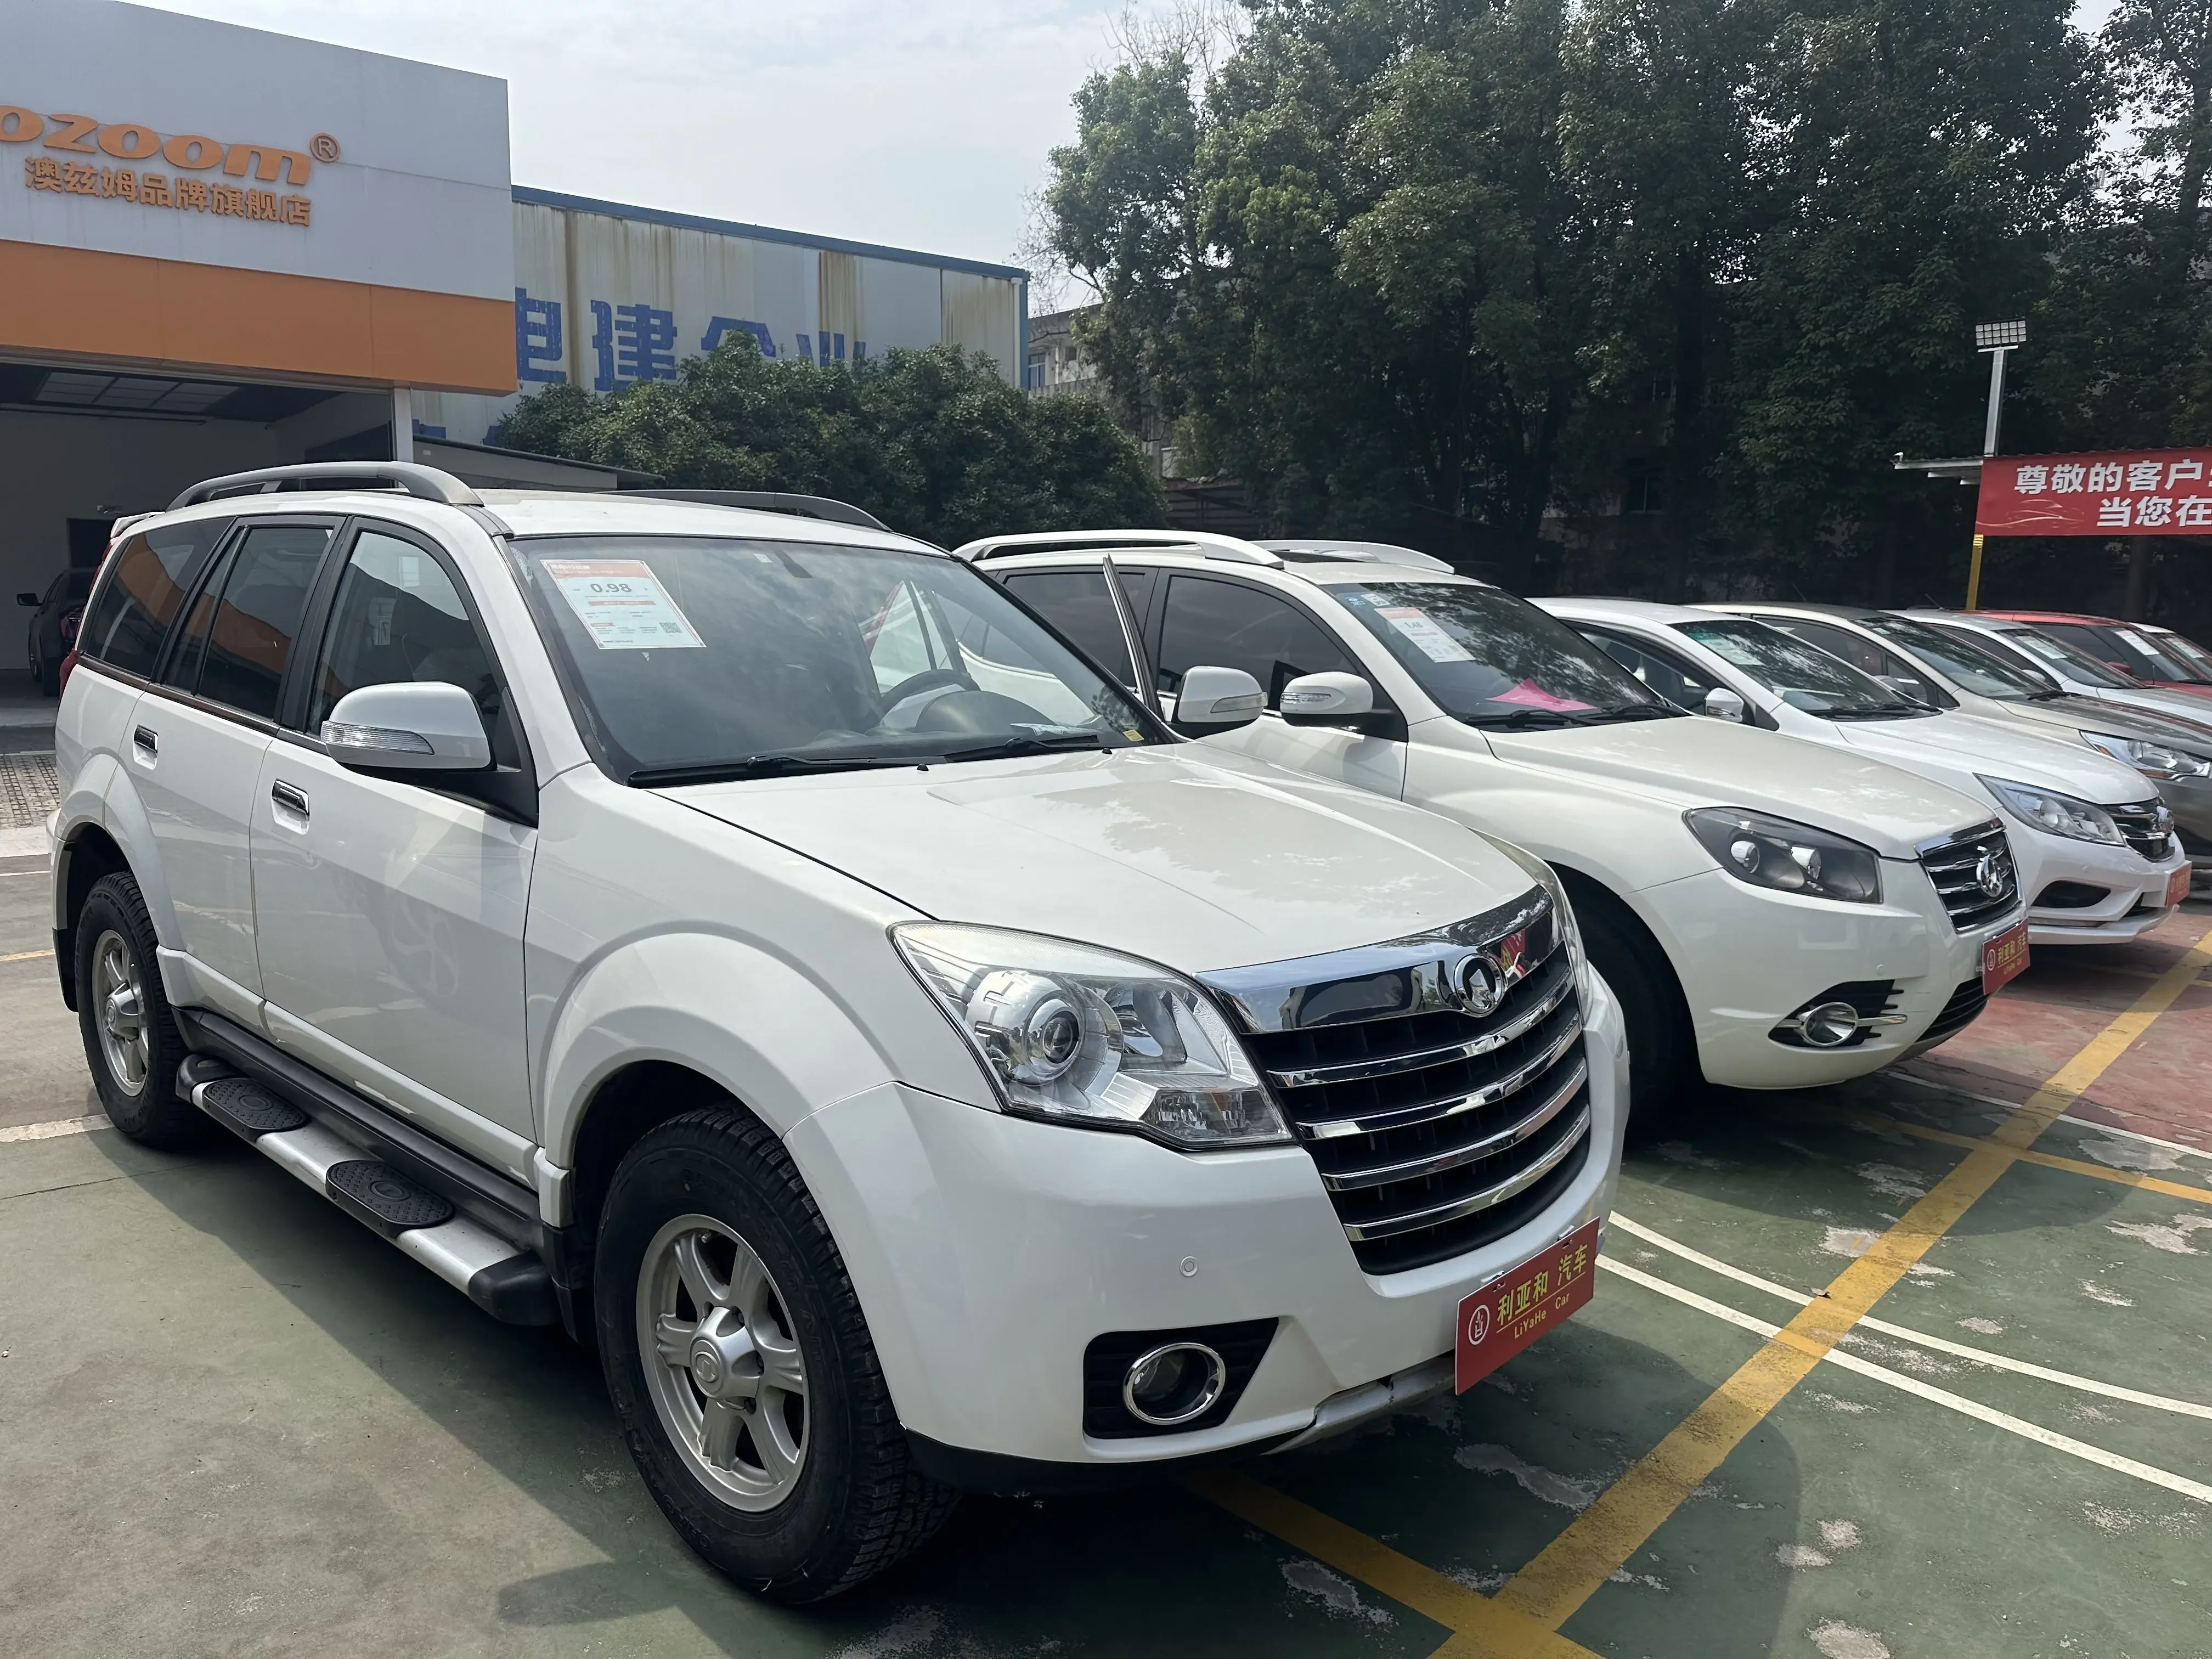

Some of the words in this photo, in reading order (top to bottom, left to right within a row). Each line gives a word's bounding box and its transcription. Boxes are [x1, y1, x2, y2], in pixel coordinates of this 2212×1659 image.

[25, 155, 312, 227] 澳兹姆品牌旗舰店
[2097, 494, 2212, 527] 当您在
[590, 583, 632, 593] 0.98
[1497, 1270, 1549, 1327] 利亚和
[1557, 1244, 1588, 1286] 汽车
[1514, 1308, 1547, 1339] LiYaHe
[1555, 1293, 1570, 1310] Car
